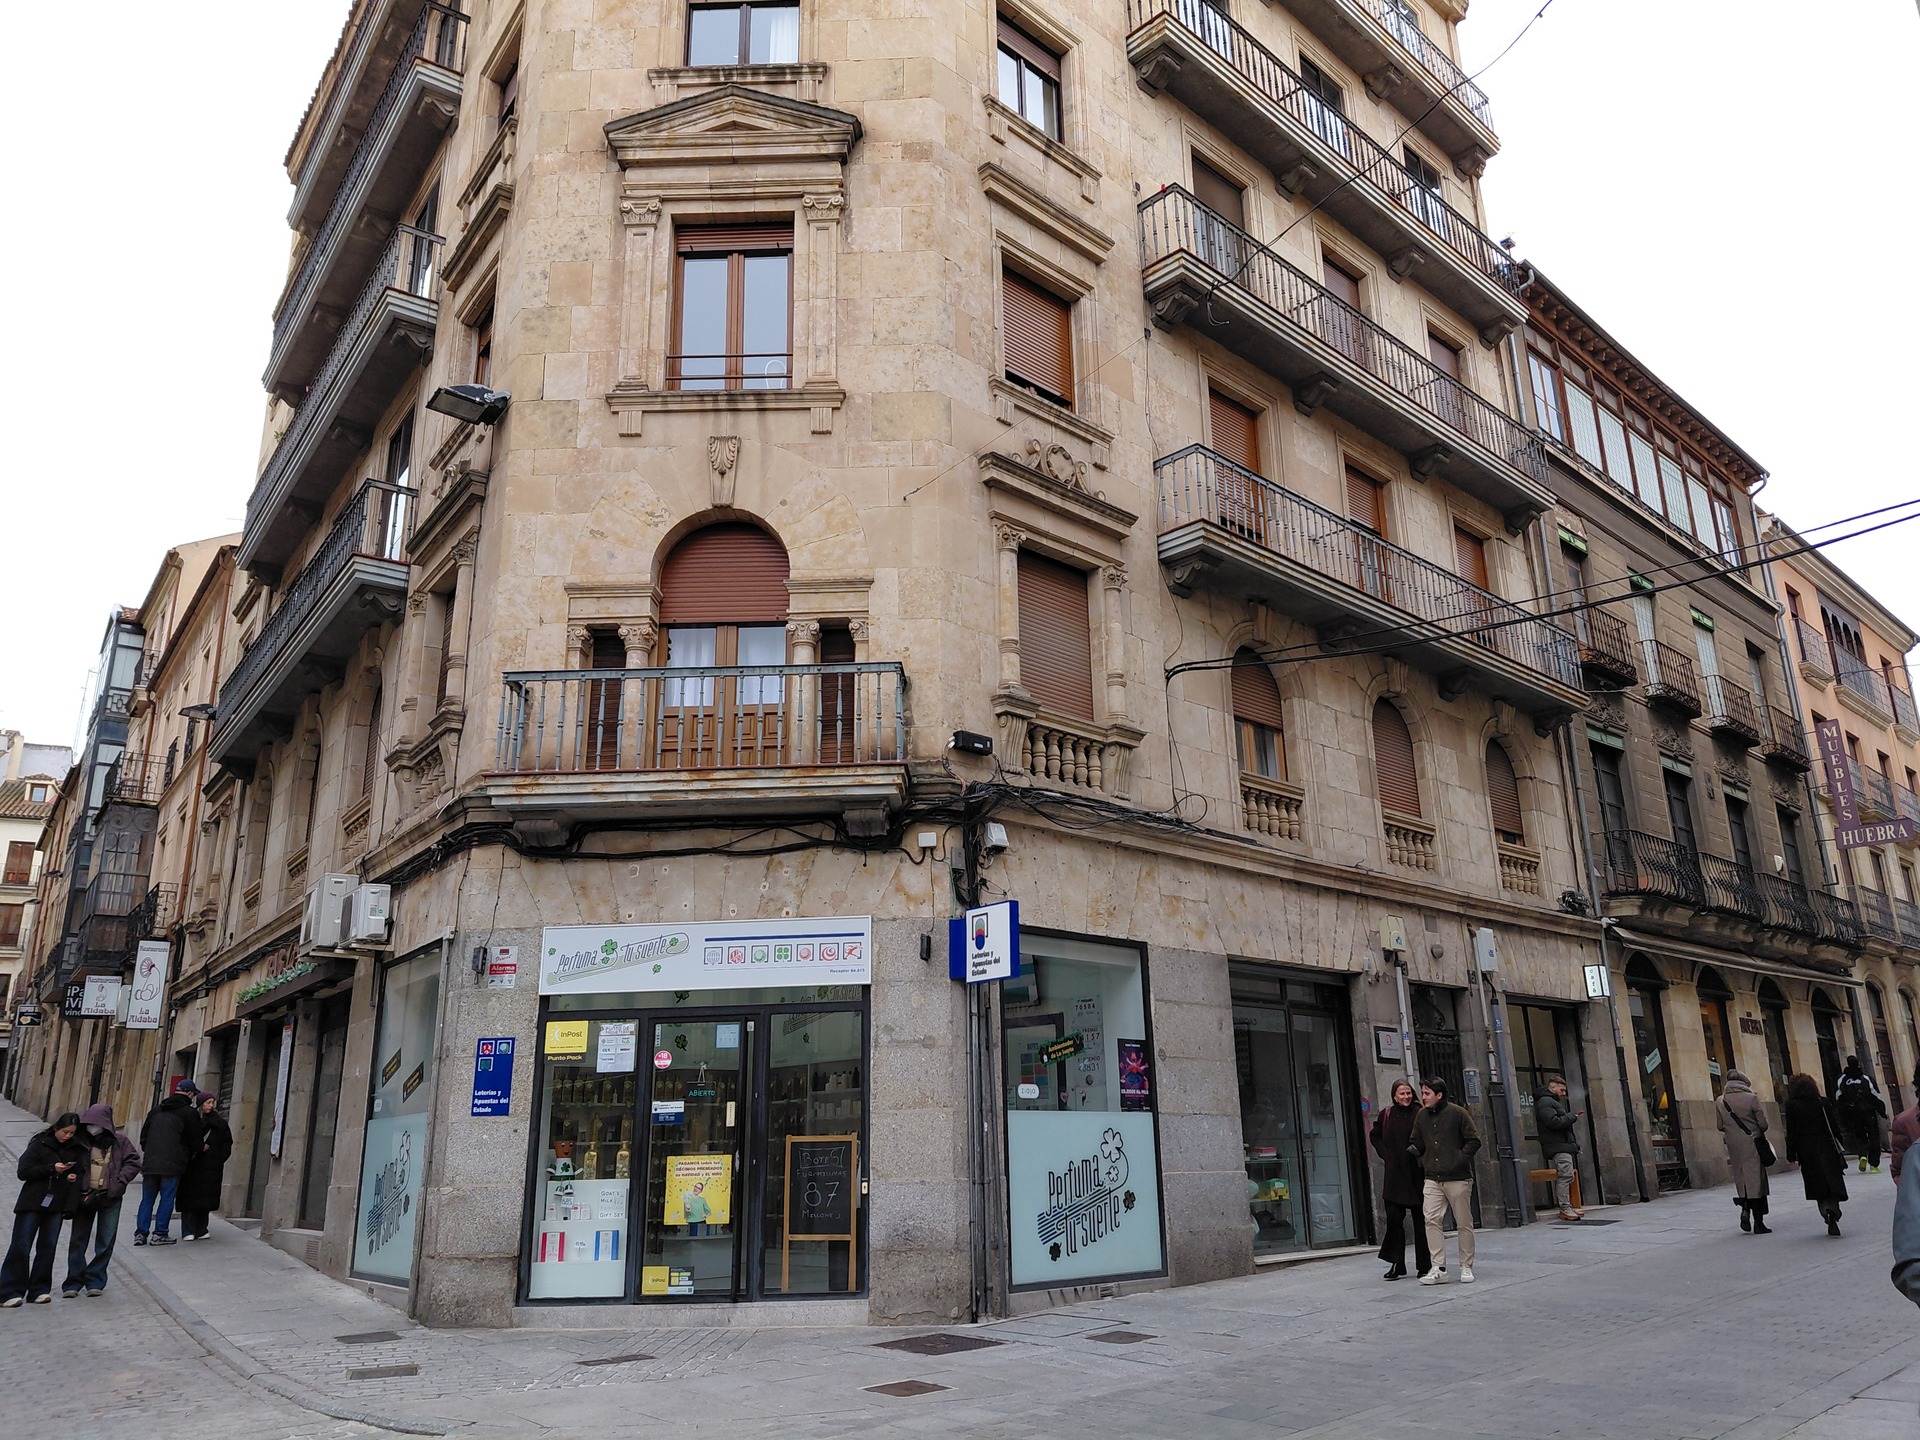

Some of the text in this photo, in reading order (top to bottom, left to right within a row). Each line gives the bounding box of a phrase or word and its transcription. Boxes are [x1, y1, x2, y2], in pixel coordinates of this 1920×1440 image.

[1823, 726, 1853, 821] MUEBLES
[1841, 824, 1908, 846] HUEBRA
[554, 950, 598, 974] Perfuma
[635, 934, 667, 960] suerte
[972, 951, 990, 960] Loterías
[972, 956, 1001, 969] Apuestas del
[972, 968, 988, 977] Estado
[1435, 971, 1440, 980] 6
[139, 1007, 150, 1015] La
[128, 1015, 158, 1024] Aldaba
[688, 1089, 716, 1097] ABIERTO
[1046, 1154, 1104, 1217] Perfuma
[804, 1181, 840, 1208] 87
[1081, 1186, 1121, 1247] suerte
